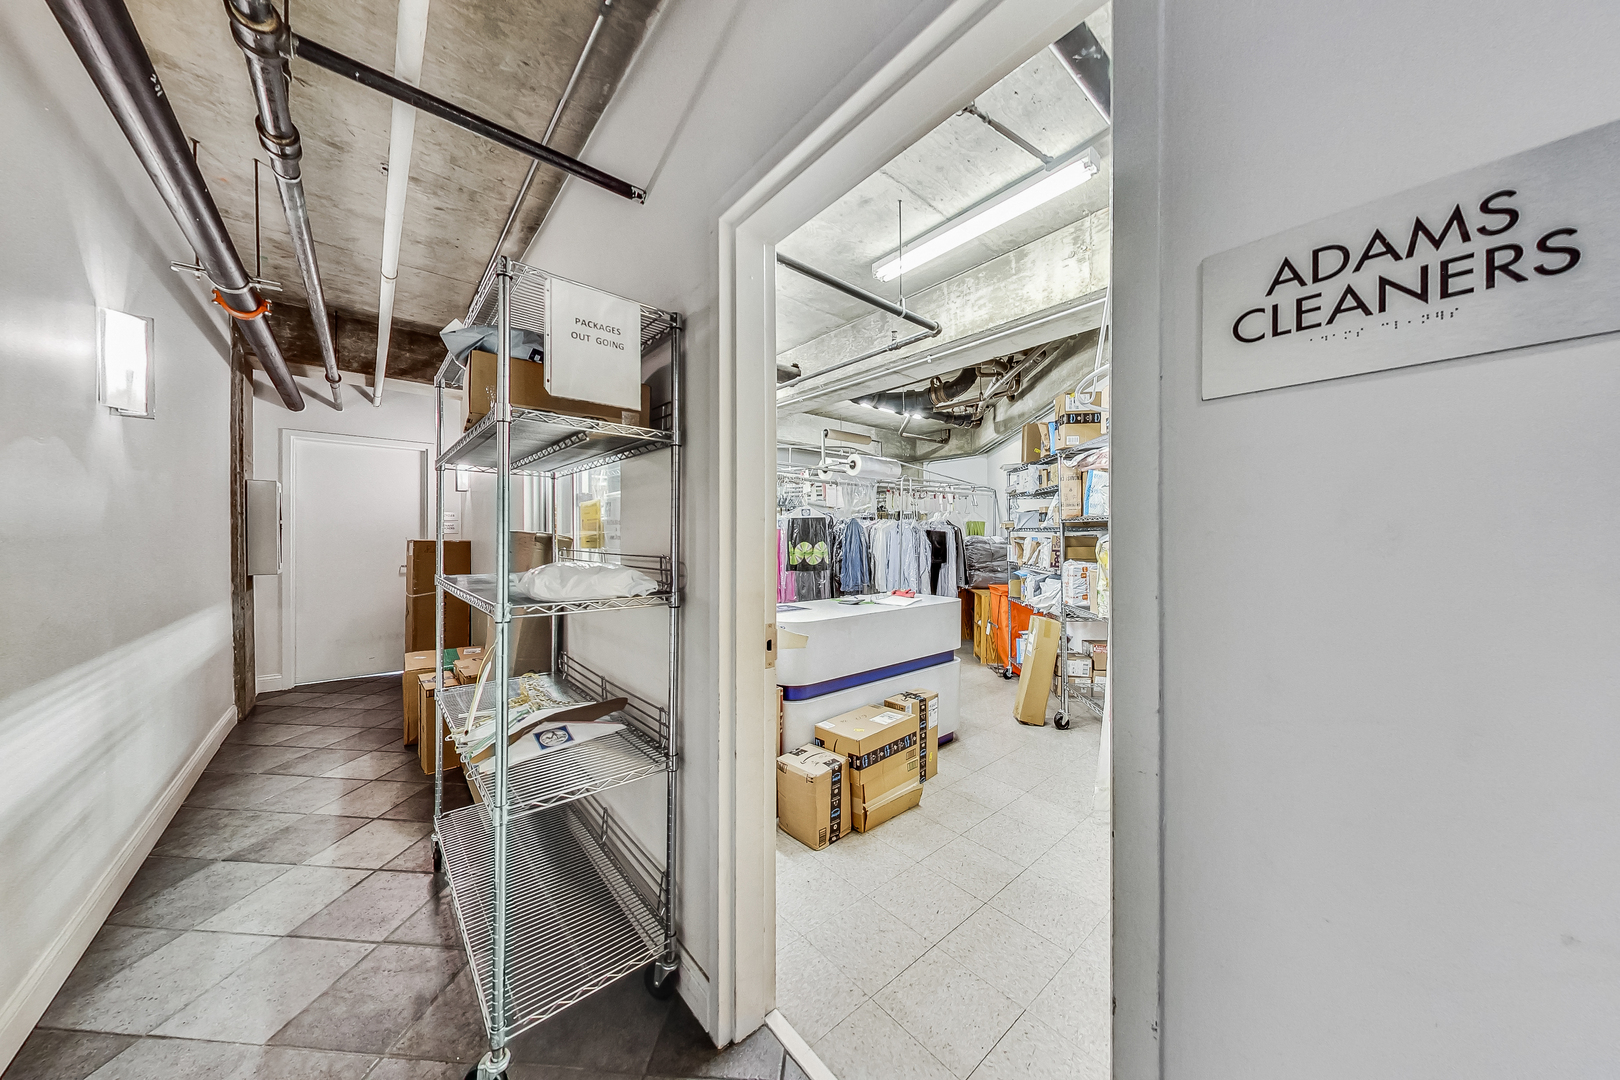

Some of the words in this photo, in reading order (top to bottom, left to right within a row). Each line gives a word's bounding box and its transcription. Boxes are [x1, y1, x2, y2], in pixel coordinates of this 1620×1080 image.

[1264, 189, 1520, 297] ADAMS
[1232, 227, 1582, 343] CLEANERS
[570, 331, 591, 342] OUT
[595, 337, 625, 351] GOING
[574, 317, 622, 336] PACKAGES
